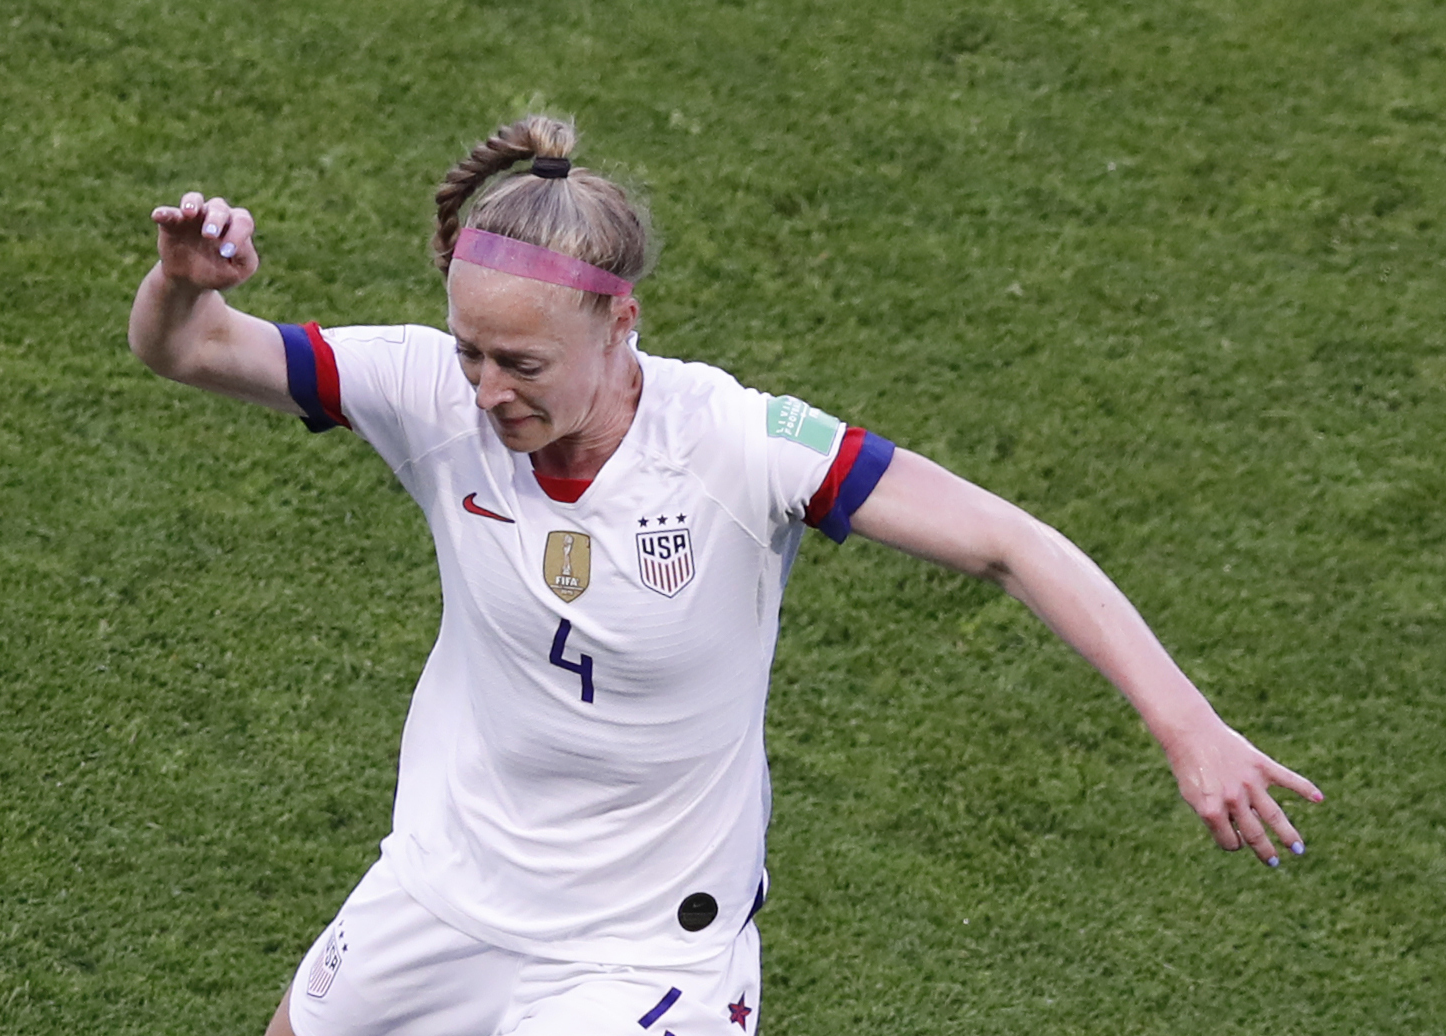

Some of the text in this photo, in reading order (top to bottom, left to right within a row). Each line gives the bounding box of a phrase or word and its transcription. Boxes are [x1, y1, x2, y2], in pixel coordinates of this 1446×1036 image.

[641, 534, 686, 560] USA
[555, 576, 578, 587] FIFA
[550, 617, 594, 704] 4
